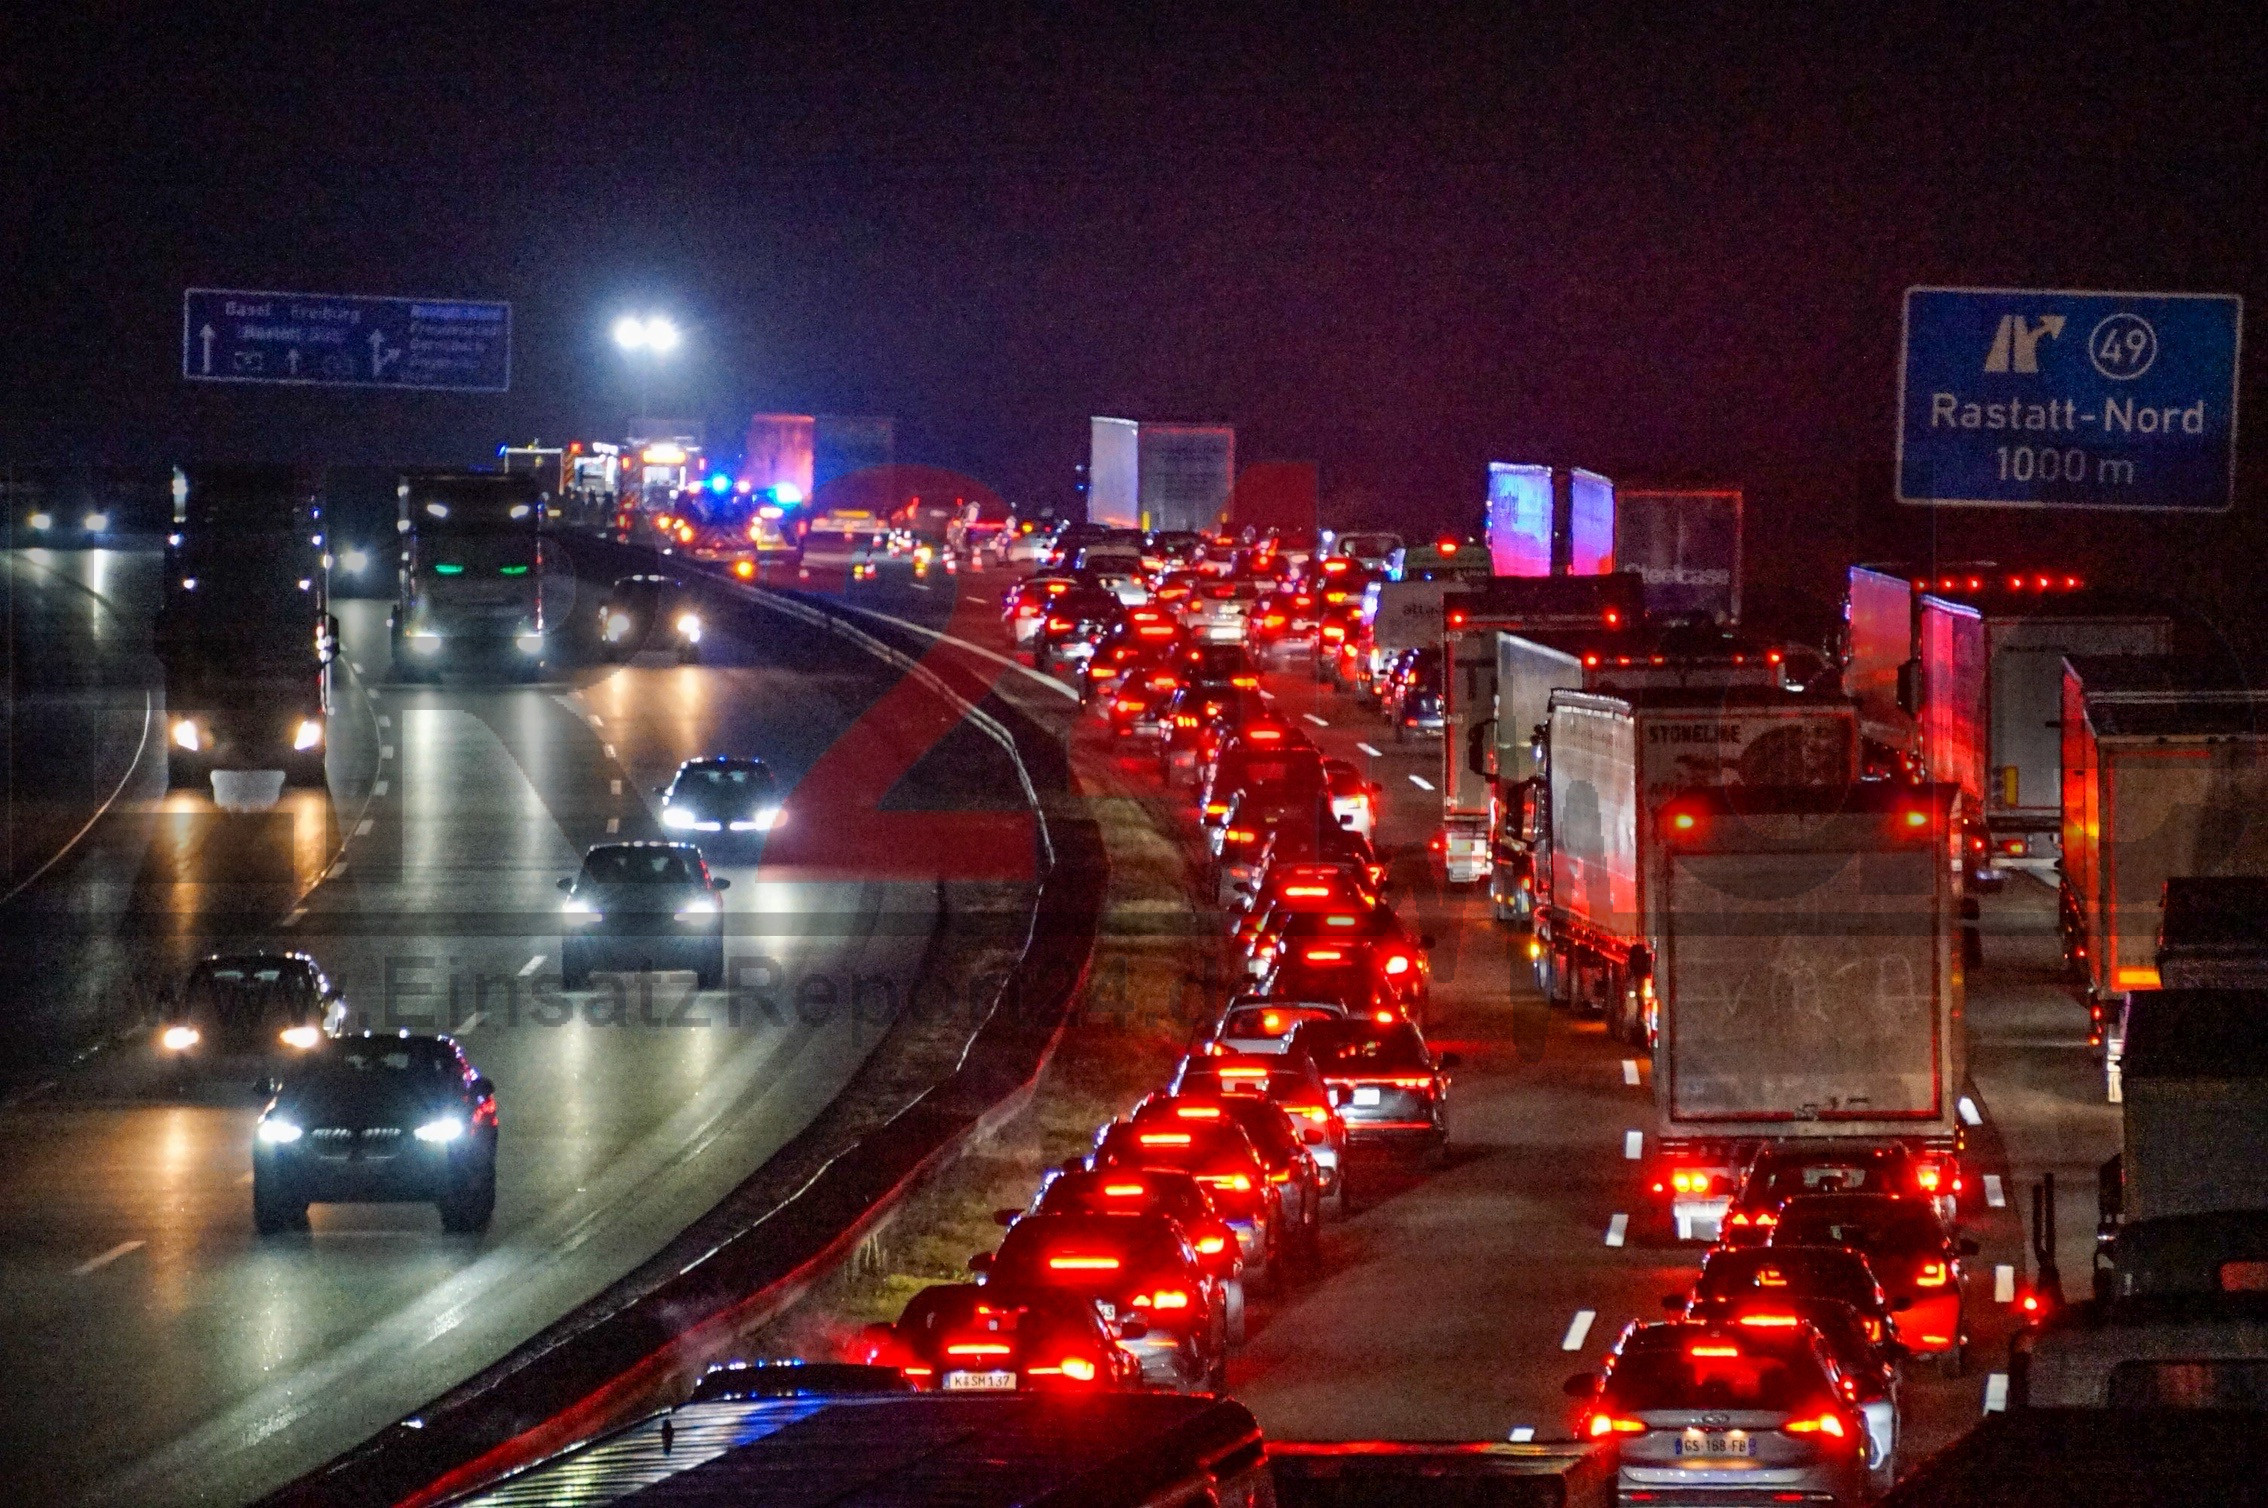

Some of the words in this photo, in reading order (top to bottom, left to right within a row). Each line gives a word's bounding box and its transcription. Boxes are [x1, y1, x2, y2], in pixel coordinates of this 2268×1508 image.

[2099, 325, 2148, 365] 49
[1930, 392, 2206, 434] Rastatt-Nord
[1995, 446, 2087, 483] 1000
[2098, 458, 2135, 485] m
[1648, 724, 1741, 744] STONELINE
